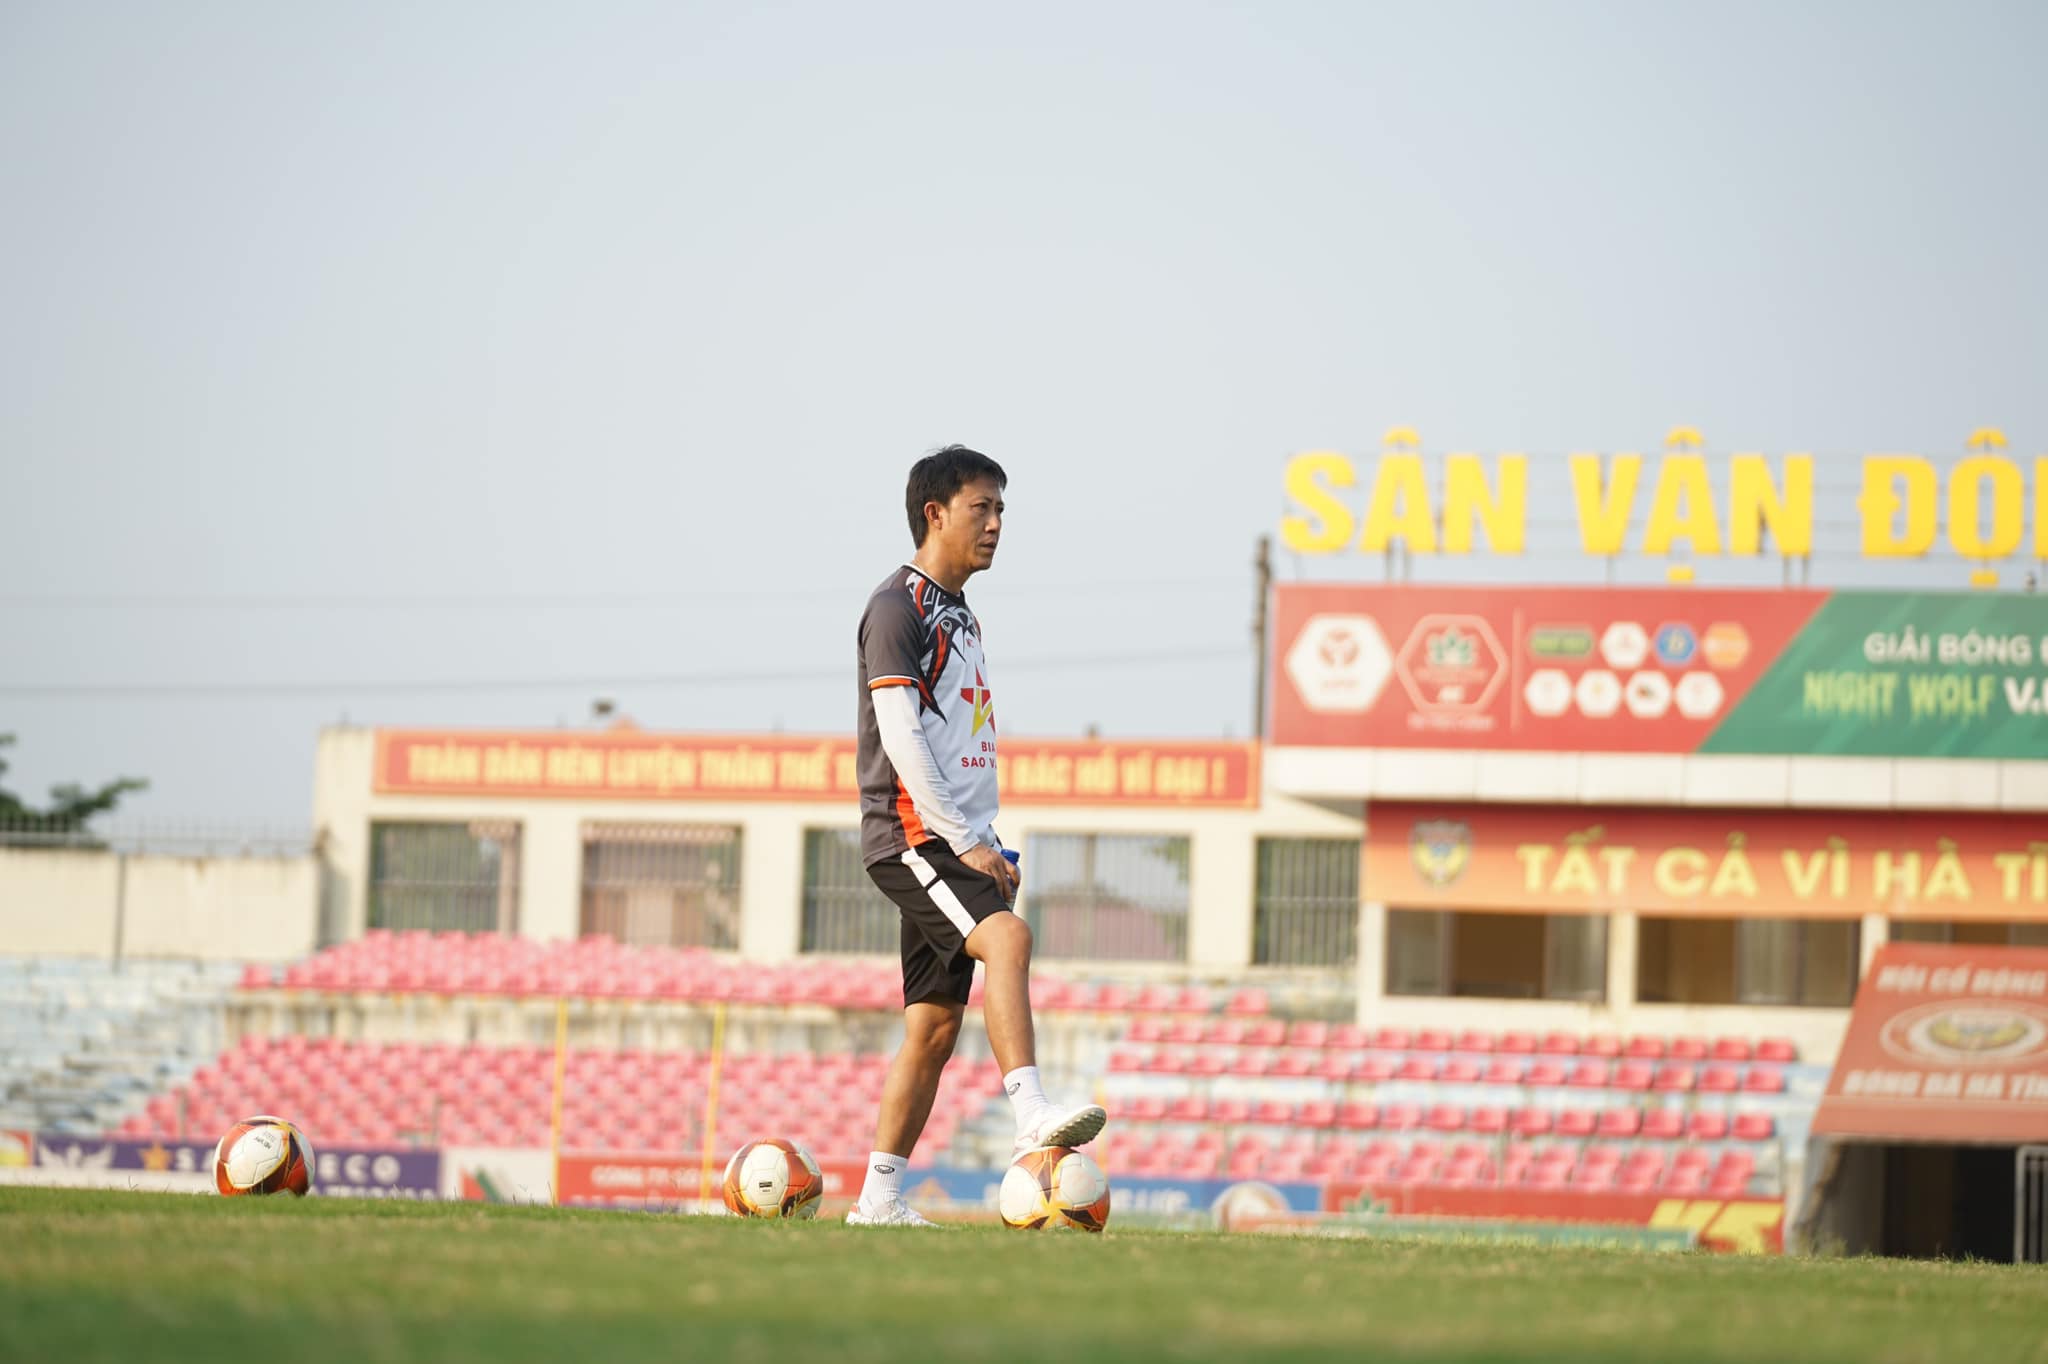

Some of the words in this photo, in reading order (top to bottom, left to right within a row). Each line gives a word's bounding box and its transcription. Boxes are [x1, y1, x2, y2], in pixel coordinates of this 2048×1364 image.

[1280, 426, 1527, 555] SÂN
[1569, 426, 1815, 585] VẬN
[1856, 427, 2048, 588] ĐỘ
[1863, 624, 1931, 665] GIẢI
[1939, 628, 2032, 666] BÓNG
[1803, 671, 1897, 722] NIGHT
[1907, 673, 1997, 724] WOLF
[961, 757, 986, 768] SAO
[1515, 824, 1637, 895] TẤT
[1654, 831, 1760, 898] CẢ
[1873, 837, 1972, 902] HÀ
